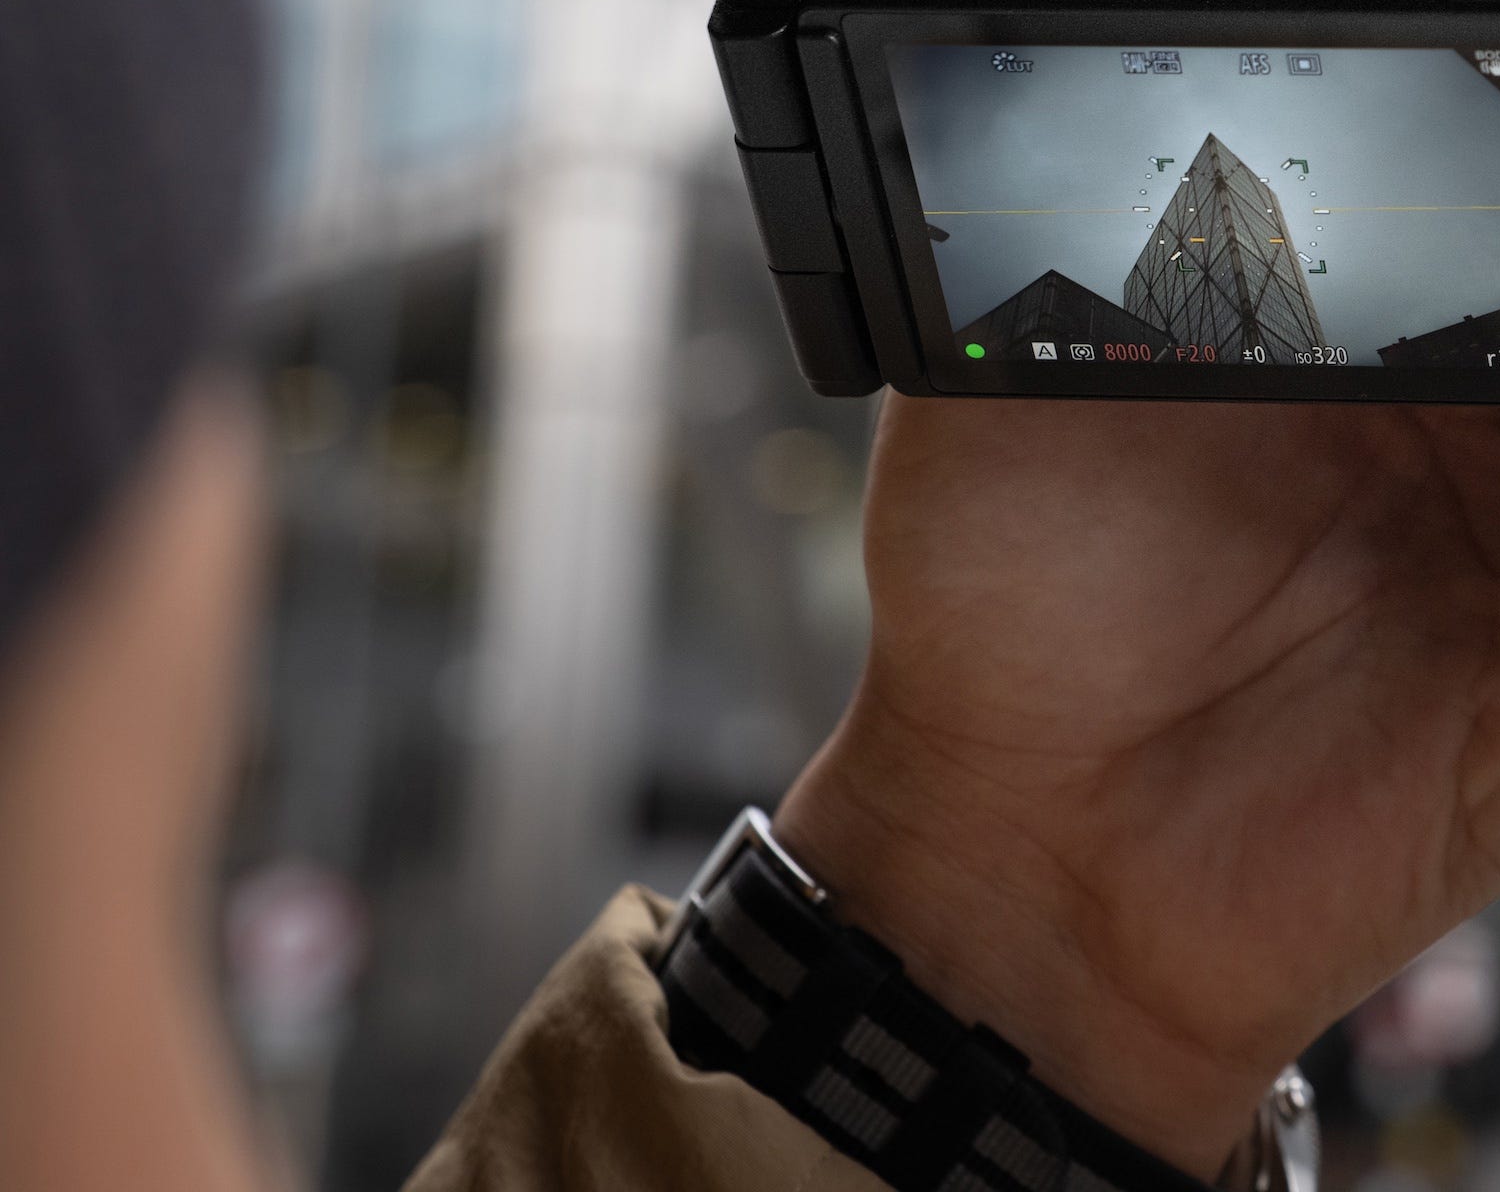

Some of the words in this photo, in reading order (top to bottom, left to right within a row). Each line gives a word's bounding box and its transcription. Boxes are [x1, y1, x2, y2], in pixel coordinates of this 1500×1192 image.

[1007, 60, 1033, 73] LUT
[1240, 53, 1271, 75] AFS
[1103, 343, 1151, 361] 8000
[1175, 344, 1216, 363] F2.0
